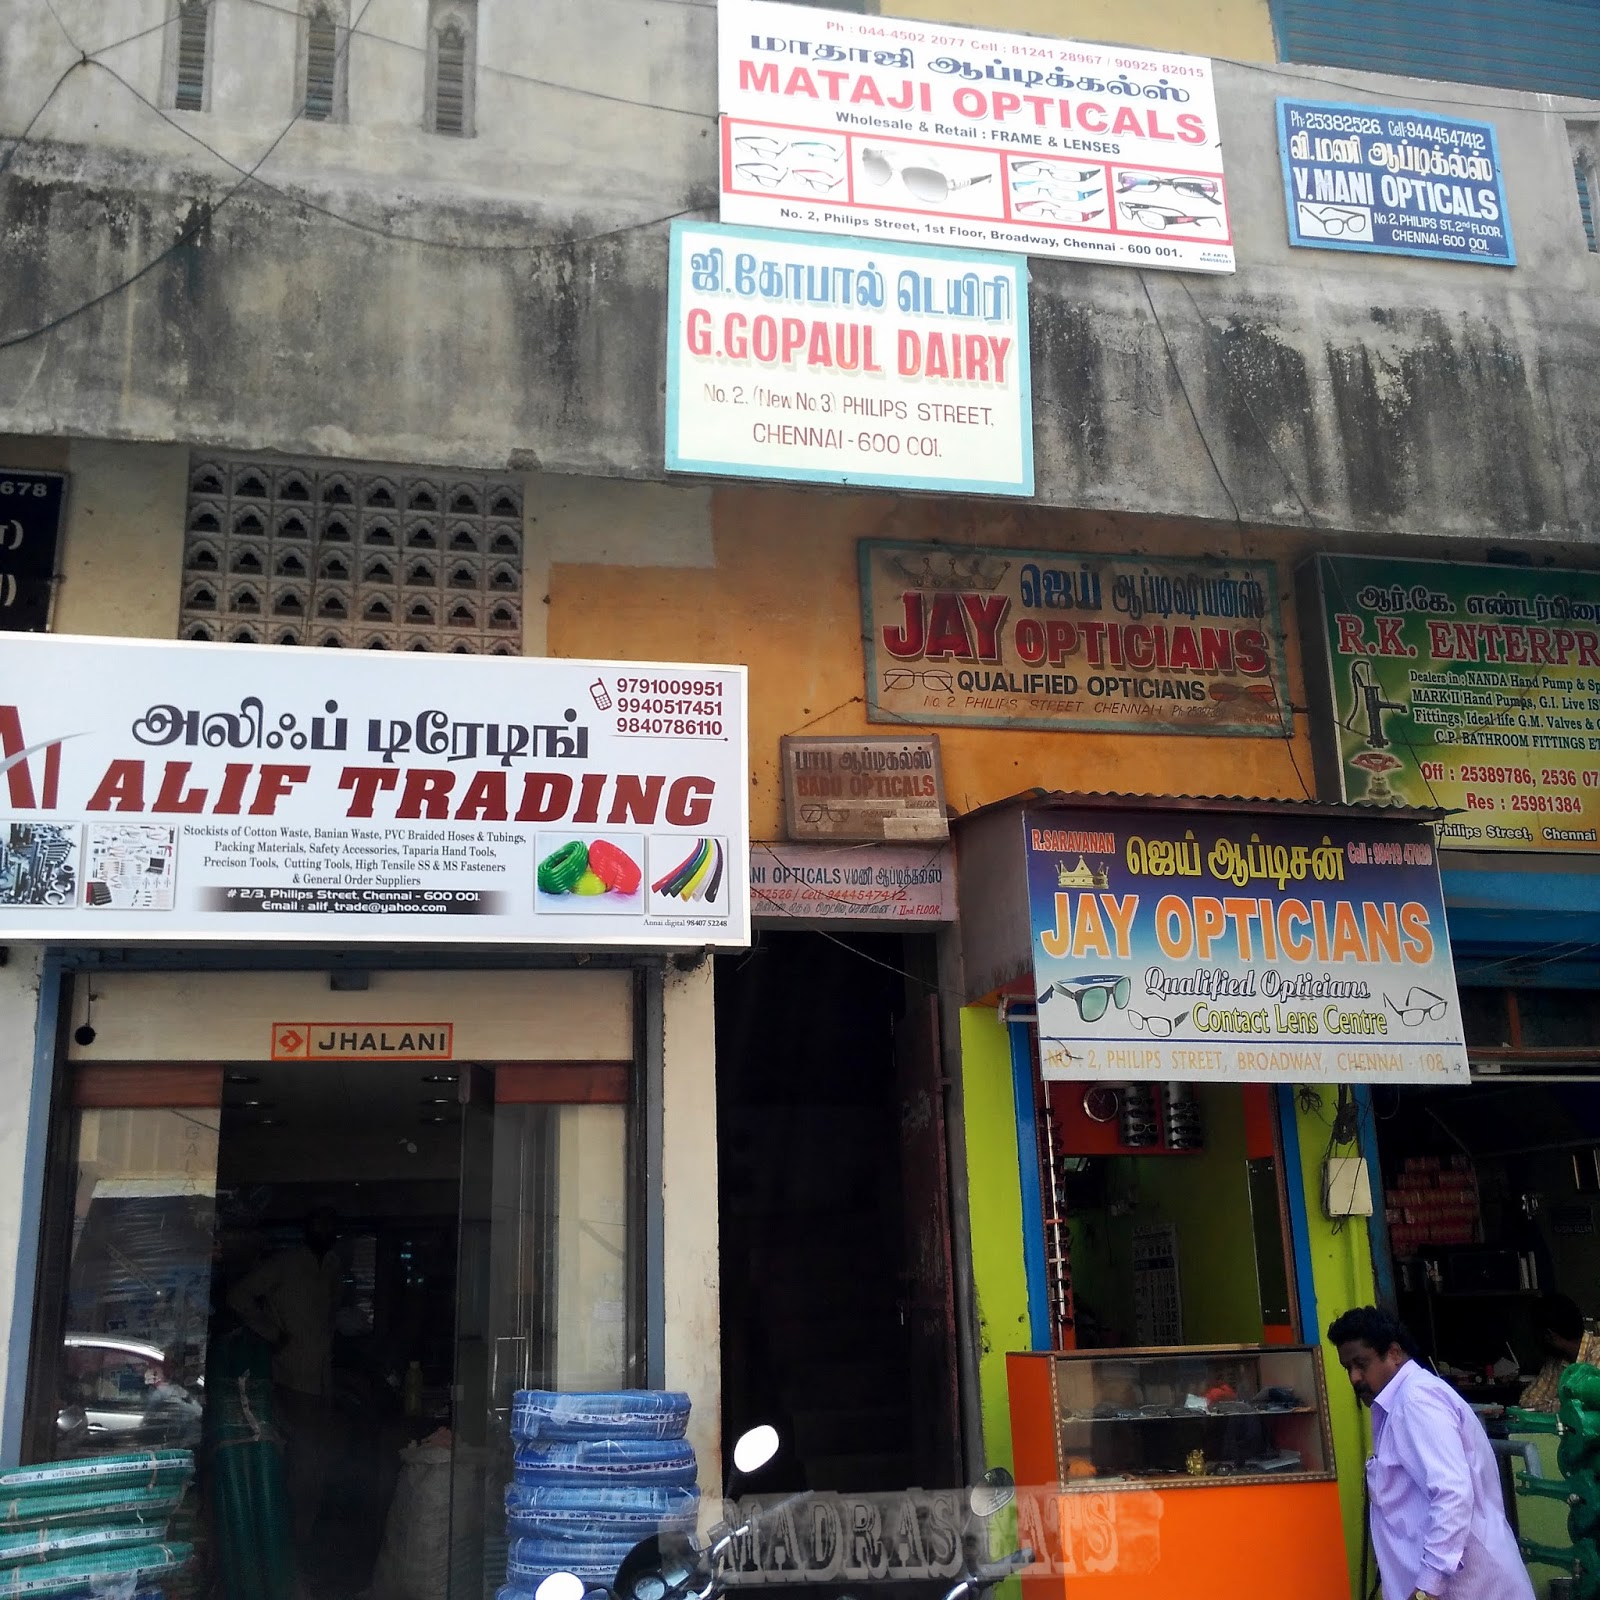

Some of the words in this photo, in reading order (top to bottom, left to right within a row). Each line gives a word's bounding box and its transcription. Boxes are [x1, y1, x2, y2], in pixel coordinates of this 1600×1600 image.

[826, 21, 844, 32] Ph
[859, 25, 925, 43] 044-4502
[931, 34, 965, 48] 2077
[970, 40, 998, 52] Cell
[1011, 45, 1054, 59] 81241
[1060, 51, 1102, 65] 28967
[1115, 58, 1158, 72] 90925
[1162, 64, 1204, 78] 82015
[750, 34, 914, 69] மாதாஜி
[927, 57, 1190, 103] ஆப்டிக்கல்ஸ்
[739, 59, 932, 112] MATAJI
[952, 87, 1208, 145] OPTICALS
[836, 112, 913, 131] Wholesale
[919, 121, 929, 132] &
[935, 124, 977, 138] Retail
[991, 130, 1042, 146] FRAME
[1048, 137, 1058, 147] &
[1064, 139, 1120, 154] LENSES
[1290, 130, 1363, 164] வி.மணி
[1293, 167, 1375, 205] V.MANI
[1381, 174, 1499, 220] OPTICALS
[780, 208, 802, 219] No.
[807, 211, 819, 222] 2,
[824, 213, 869, 227] Philips
[875, 219, 920, 233] Street,
[925, 224, 945, 234] 1st
[950, 227, 985, 240] Floor,
[991, 231, 1059, 247] Broadway,
[1064, 238, 1116, 252] Chennai
[1128, 245, 1151, 255] 600
[1155, 248, 1183, 258] 001.
[1400, 214, 1437, 229] PHILIPS
[1471, 223, 1503, 238] FLOOR,
[691, 247, 884, 308] ஜி.கோபால்
[898, 269, 1012, 322] டெயிரி
[686, 308, 882, 373] G.GOPAUL
[898, 328, 1012, 384] DAIRY
[843, 396, 908, 420] PHILIPS
[753, 423, 843, 449] CHENNAI
[858, 432, 900, 454] 600
[1020, 562, 1102, 611] ஜெய்
[882, 591, 1010, 661] JAY
[1015, 618, 1269, 674] OPTICIANS
[1336, 616, 1417, 657] R.K.
[616, 677, 724, 697] 9791009951
[957, 670, 1078, 695] QUALIFIED
[1087, 678, 1206, 701] OPTICIANS
[1410, 671, 1446, 683] Dealers
[1468, 672, 1508, 687] NANDA
[1510, 674, 1539, 688] Hand
[1542, 677, 1573, 693] Pump
[616, 697, 724, 717] 9940517451
[1029, 700, 1084, 713] STREET
[1412, 689, 1448, 703] MARK
[1463, 692, 1492, 706] Hand
[1495, 694, 1536, 710] Pumps,
[1562, 698, 1585, 710] Live
[616, 717, 724, 736] 9840786110
[1414, 708, 1464, 727] Fittings,
[1467, 712, 1495, 726] Ideal
[1498, 714, 1515, 726] life
[1518, 715, 1544, 728] G.M.
[1546, 716, 1582, 730] Valves
[132, 696, 348, 751] அலிஃப்
[368, 708, 589, 767] டிரேடிங்
[1462, 732, 1529, 747] BATHROOM
[1532, 735, 1586, 750] FITTINGS
[850, 775, 935, 797] OPTICALS
[1422, 763, 1443, 780] Off
[1461, 766, 1537, 787] 25389786,
[1542, 770, 1577, 786] 2536
[86, 759, 311, 816] ALIF
[337, 766, 716, 827] TRADING
[1466, 793, 1494, 810] Res
[1511, 795, 1582, 813] 25981384
[183, 825, 229, 837] Stockists
[231, 826, 241, 836] of
[244, 827, 278, 838] Cotton
[280, 827, 312, 839] Waste,
[314, 828, 349, 839] Banian
[351, 829, 382, 841] Waste,
[385, 829, 406, 840] PVC
[408, 829, 445, 841] Braided
[448, 831, 475, 842] Hoses
[487, 832, 526, 845] Tubings,
[1031, 828, 1115, 853] R.SARAVANAN
[1436, 824, 1482, 840] Philips
[1486, 826, 1533, 841] Street,
[1543, 828, 1597, 841] Chennai
[215, 841, 255, 854] Packing
[257, 842, 307, 854] Materials,
[309, 843, 340, 856] Safety
[343, 844, 400, 857] Accessories,
[402, 845, 440, 858] Taparia
[442, 846, 467, 857] Hand
[469, 847, 497, 859] Tools,
[1126, 829, 1202, 876] ஜெய்
[1208, 832, 1344, 891] ஆப்டிசன்
[1347, 841, 1368, 864] Cell
[204, 856, 247, 868] Precison
[250, 857, 279, 869] Tools,
[284, 858, 322, 871] Cutting
[324, 859, 353, 871] Tools,
[355, 859, 378, 872] High
[381, 860, 416, 871] Tensile
[417, 861, 431, 871] SS
[443, 861, 458, 871] MS
[460, 861, 506, 872] Fasteners
[773, 867, 841, 884] OPTICALS
[303, 874, 342, 885] General
[344, 874, 373, 885] Order
[375, 875, 421, 888] Suppliers
[270, 889, 314, 900] Philips
[363, 890, 413, 901] Chennai
[424, 891, 453, 901] 600
[261, 901, 298, 911] Email
[307, 901, 447, 914] alif_trade@yahoo.com
[686, 919, 706, 927] 98407
[707, 919, 728, 927] 52248
[1040, 892, 1140, 960] JAY
[1155, 895, 1435, 965] OPTICIANS
[1145, 966, 1256, 1000] Qualified
[1259, 969, 1370, 1003] Opticians
[1192, 1001, 1270, 1033] Contact
[1274, 1003, 1318, 1034] Lens
[1323, 1004, 1388, 1035] Centre
[319, 1032, 445, 1050] JHALANI
[1107, 1050, 1161, 1069] PHILIPS
[1171, 1050, 1228, 1073] STREET,
[1238, 1051, 1328, 1074] BROADWAY,
[1337, 1052, 1404, 1072] CHENNAI
